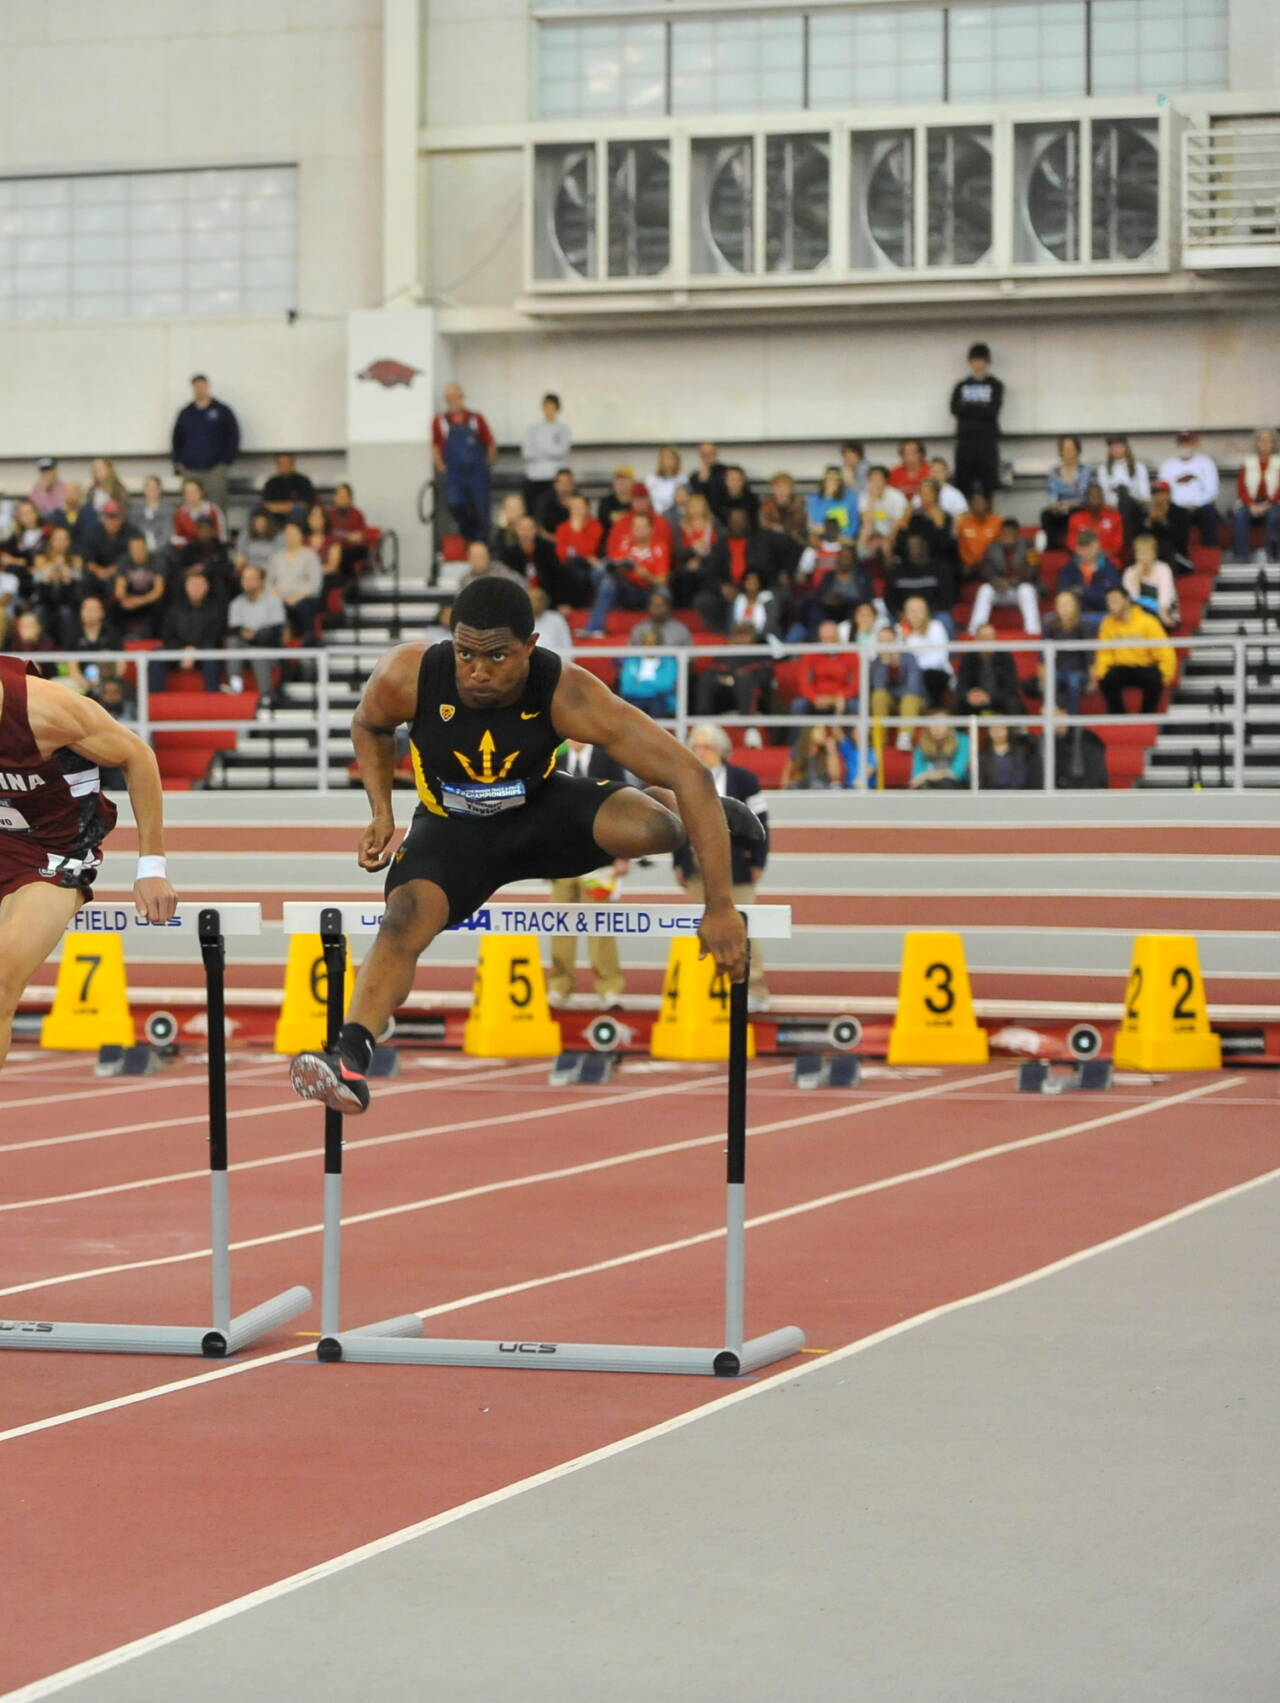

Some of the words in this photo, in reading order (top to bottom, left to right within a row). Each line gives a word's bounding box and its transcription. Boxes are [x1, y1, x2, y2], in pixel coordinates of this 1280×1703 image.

[74, 910, 128, 931] FIELD
[502, 911, 569, 932] TRACK
[576, 911, 589, 933] &
[595, 912, 651, 933] FIELD
[75, 954, 103, 1002] 7
[509, 957, 533, 1008] 5
[924, 962, 956, 1014] 3
[1125, 964, 1143, 1019] 2
[1170, 966, 1197, 1019] 2
[498, 1343, 558, 1354] UCS
